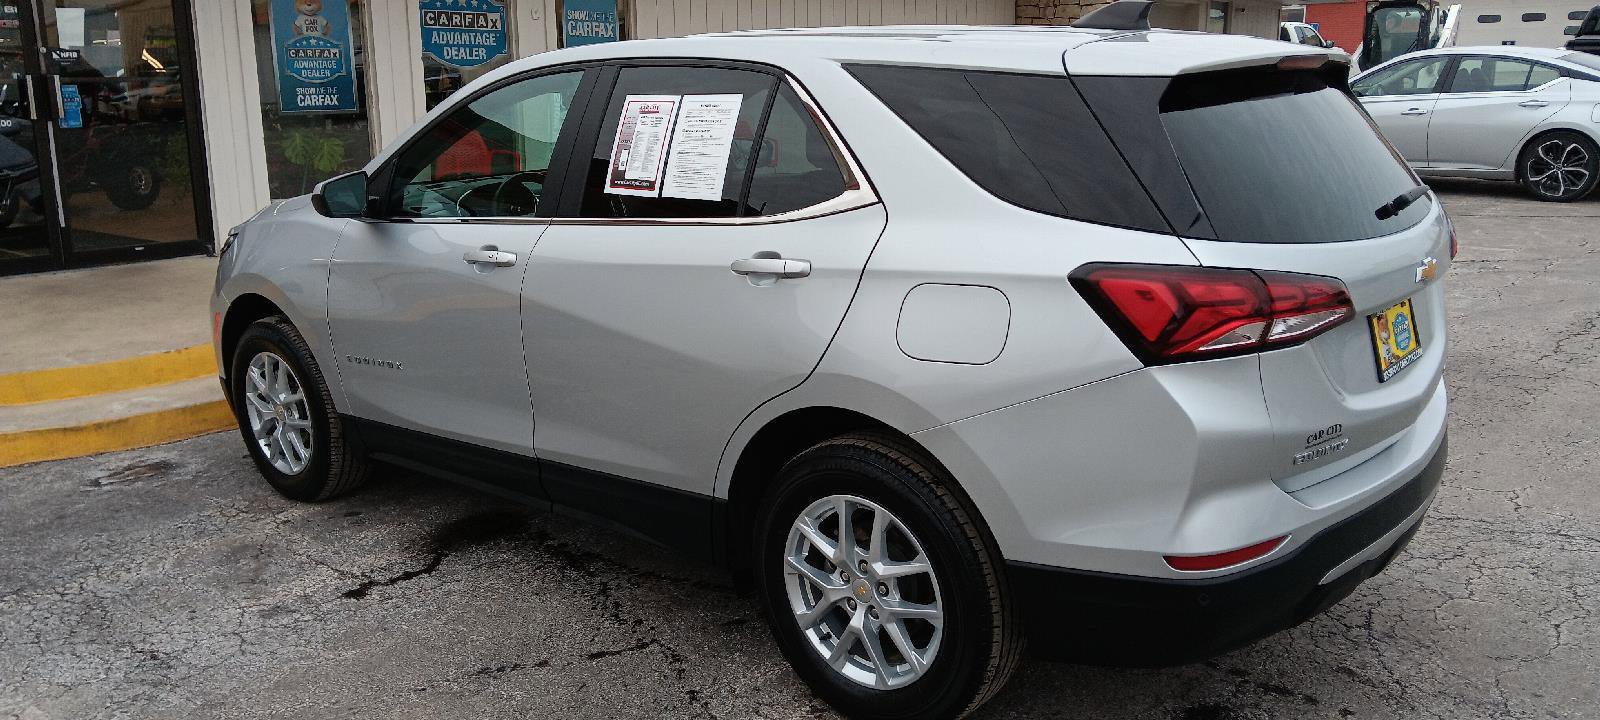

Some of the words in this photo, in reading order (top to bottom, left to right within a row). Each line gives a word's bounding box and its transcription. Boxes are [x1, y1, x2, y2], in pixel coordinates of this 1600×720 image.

[424, 11, 500, 29] CARFAX
[567, 9, 589, 21] SHOW
[567, 20, 615, 38] CARFAX
[431, 30, 496, 46] ADVANTAGE
[288, 48, 339, 59] CARFAX
[443, 46, 487, 60] DEALER
[293, 60, 337, 69] ADVANTAGE
[301, 69, 331, 77] DEALER
[295, 87, 316, 95] SHOW
[296, 94, 339, 107] CARFAX
[1306, 429, 1325, 445] CAR
[1326, 423, 1343, 436] CITY
